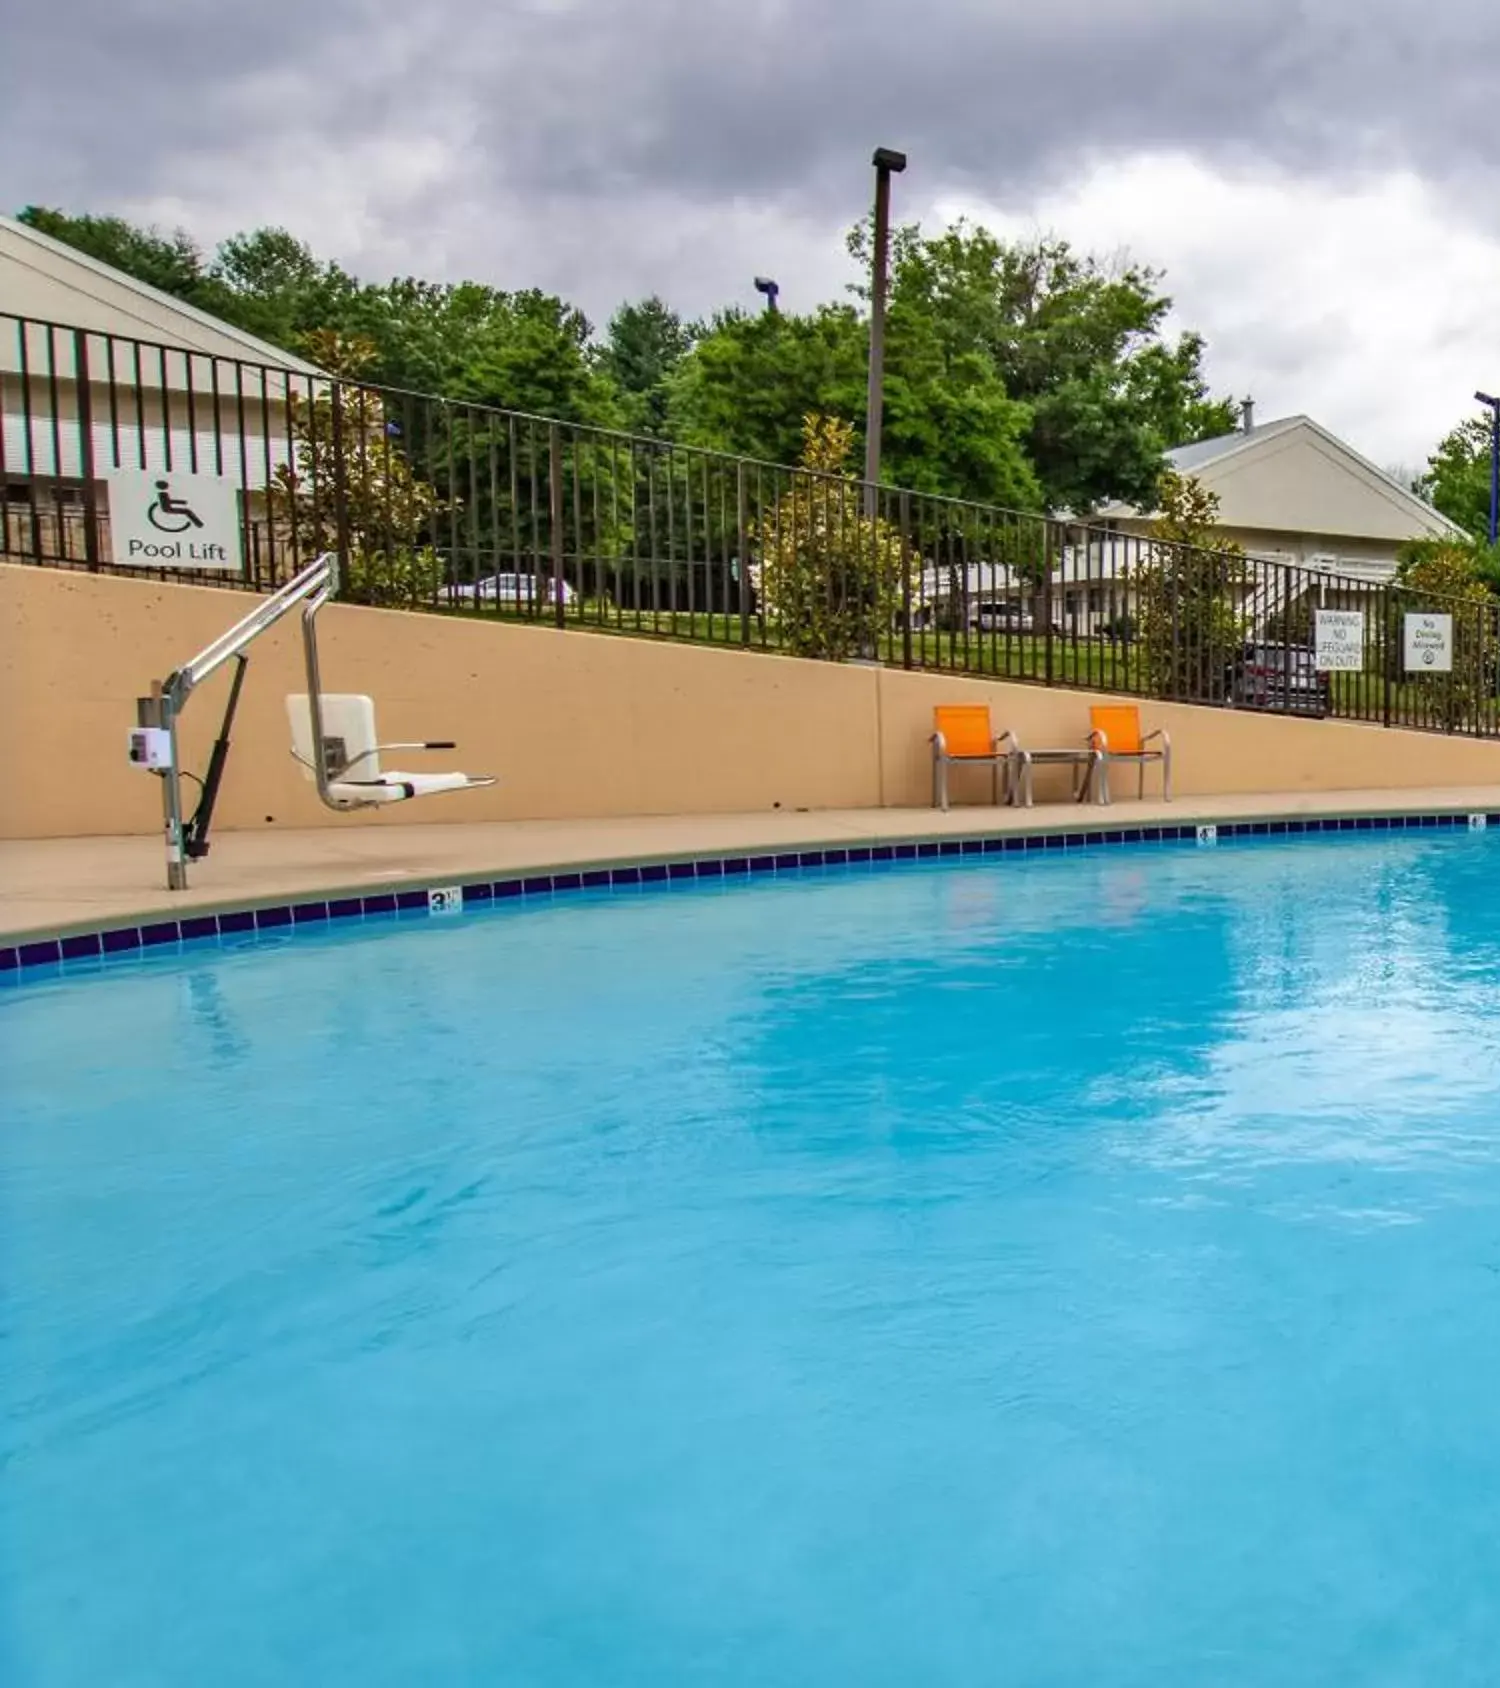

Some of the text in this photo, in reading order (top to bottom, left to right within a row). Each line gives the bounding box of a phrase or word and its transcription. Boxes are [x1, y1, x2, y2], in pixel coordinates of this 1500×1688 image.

[129, 539, 226, 561] Pool Lift
[1319, 614, 1360, 627] WARNING
[1423, 620, 1435, 629] No
[1333, 628, 1347, 641] NO
[1412, 641, 1445, 651] Allowed
[1320, 655, 1359, 668] ON DUTY
